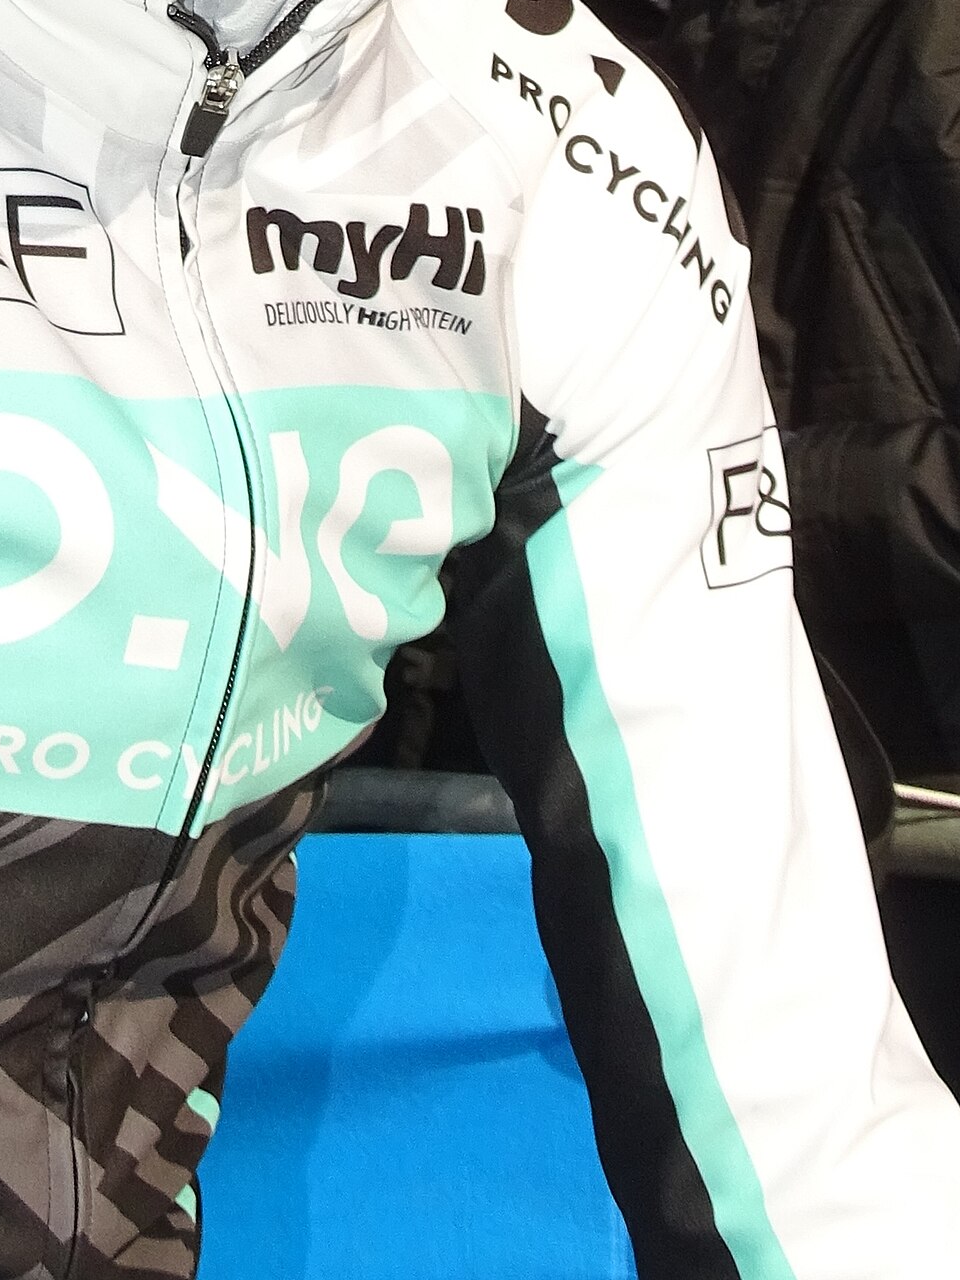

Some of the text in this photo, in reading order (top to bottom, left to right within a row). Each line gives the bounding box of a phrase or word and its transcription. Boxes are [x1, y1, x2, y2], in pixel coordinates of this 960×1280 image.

[490, 52, 572, 137] PRO
[265, 301, 355, 327] DELICIOUSLY
[117, 685, 334, 805] CYCLING
